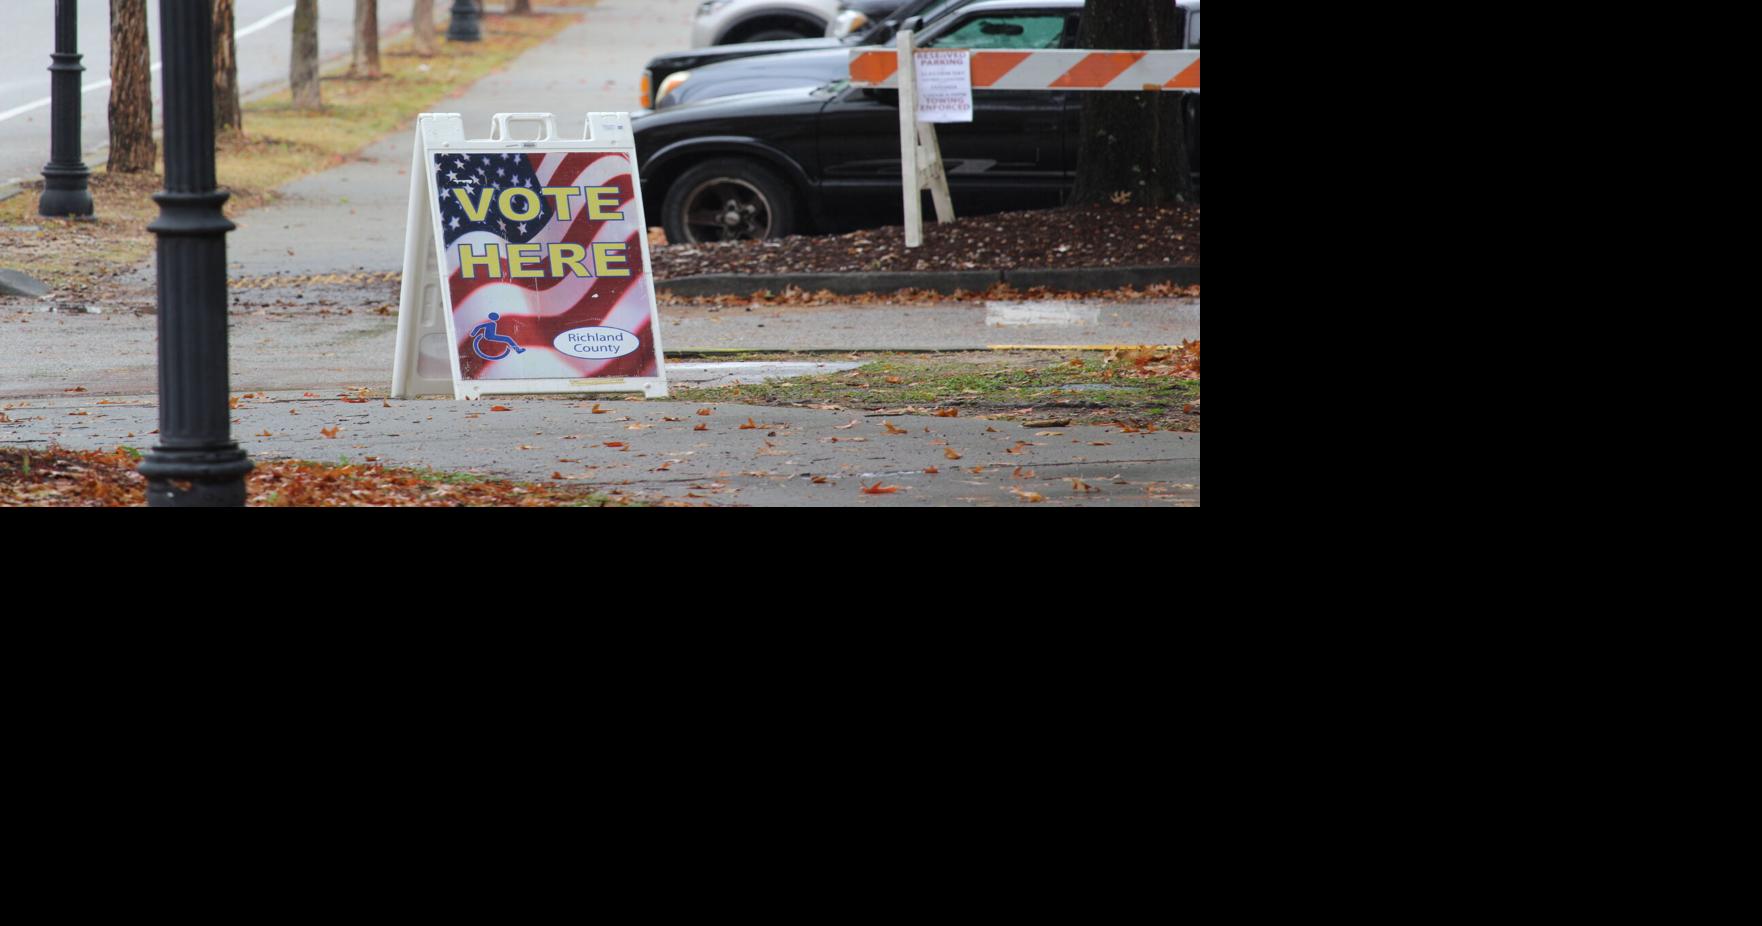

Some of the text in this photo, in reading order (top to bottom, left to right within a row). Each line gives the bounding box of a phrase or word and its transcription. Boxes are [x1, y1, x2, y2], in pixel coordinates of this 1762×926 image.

[920, 104, 970, 112] ENFORCED
[452, 186, 624, 222] VOTE
[457, 242, 631, 279] HERE
[568, 332, 624, 342] Richland
[573, 343, 620, 354] County
